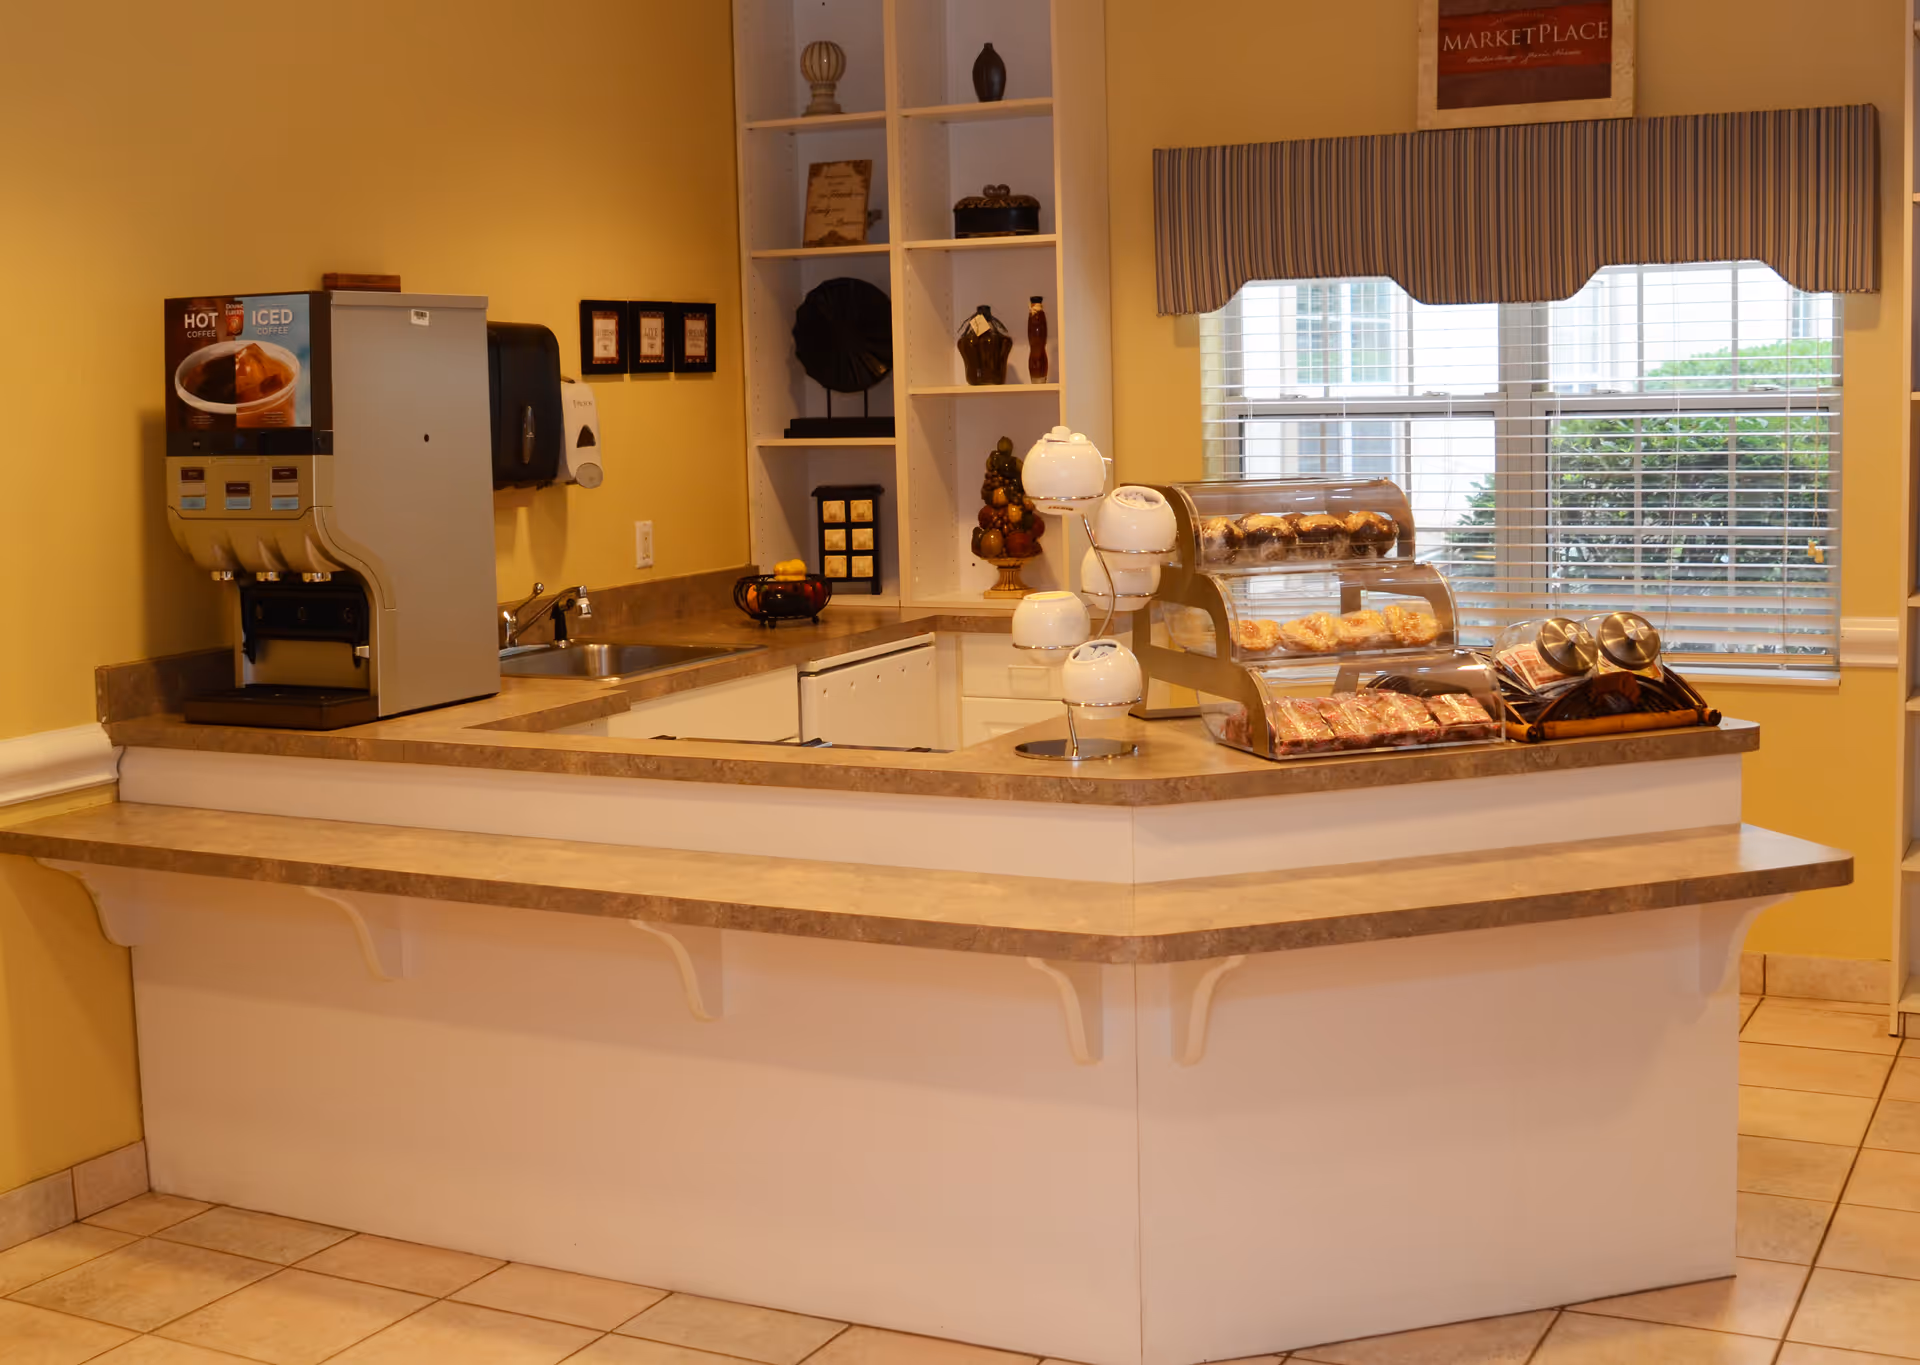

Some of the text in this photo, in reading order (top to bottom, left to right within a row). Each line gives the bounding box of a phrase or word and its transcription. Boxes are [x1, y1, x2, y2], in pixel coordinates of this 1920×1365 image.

[184, 312, 219, 328] HOT
[251, 309, 293, 325] ICED
[186, 330, 216, 338] COFFEE
[256, 327, 289, 335] COFFEE
